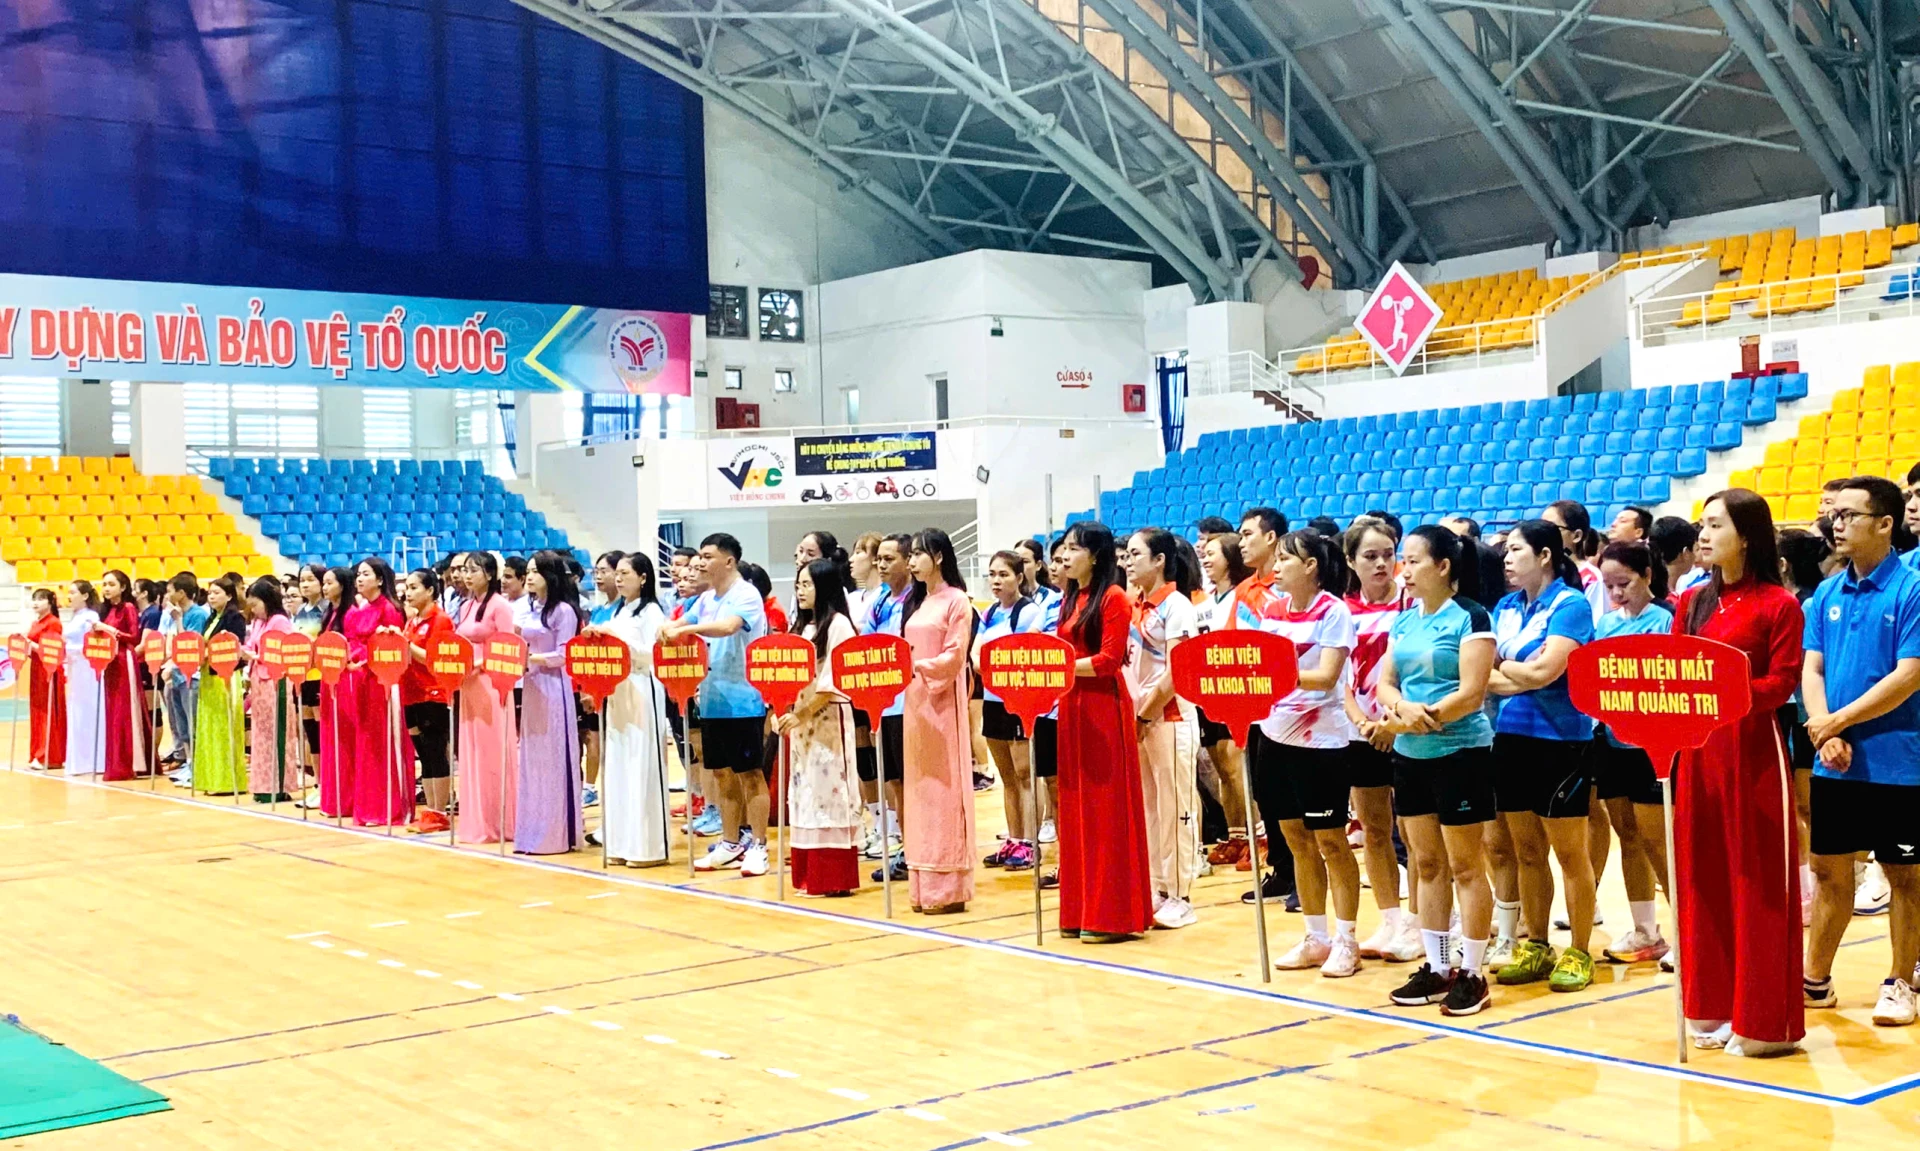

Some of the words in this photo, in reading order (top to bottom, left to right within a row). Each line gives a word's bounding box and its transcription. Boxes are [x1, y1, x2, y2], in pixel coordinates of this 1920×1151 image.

[30, 306, 145, 371] DỰNG
[154, 304, 209, 364] VÀ
[217, 298, 296, 368] BẢO
[303, 311, 351, 379] VỆ
[359, 306, 405, 371] TỔ
[413, 312, 507, 377] QUỐC
[1087, 371, 1093, 381] 4
[843, 650, 865, 667] TRUNG
[866, 646, 881, 664] TÂM
[882, 648, 887, 663] Y
[888, 642, 897, 662] TẾ
[990, 646, 1011, 668] BỆNH
[1012, 646, 1030, 668] VIỆN
[1031, 649, 1043, 665] ĐA
[1044, 649, 1066, 665] KHOA
[1206, 644, 1234, 669] BỆNH
[1236, 643, 1261, 669] VIỆN
[1599, 653, 1639, 683] BỆNH
[1641, 654, 1677, 685] VIỆN
[1680, 651, 1714, 681] MẮT
[841, 673, 855, 690] KHU
[992, 671, 1008, 687] KHU
[1009, 670, 1025, 691] VỰC
[1046, 671, 1065, 687] LINH
[1200, 677, 1215, 695] ĐA
[1217, 677, 1246, 694] KHOA
[1246, 671, 1273, 695] TỈNH
[1600, 690, 1634, 712] NAM
[1638, 685, 1690, 715] QUẢNG
[1693, 693, 1719, 720] TRỊ
